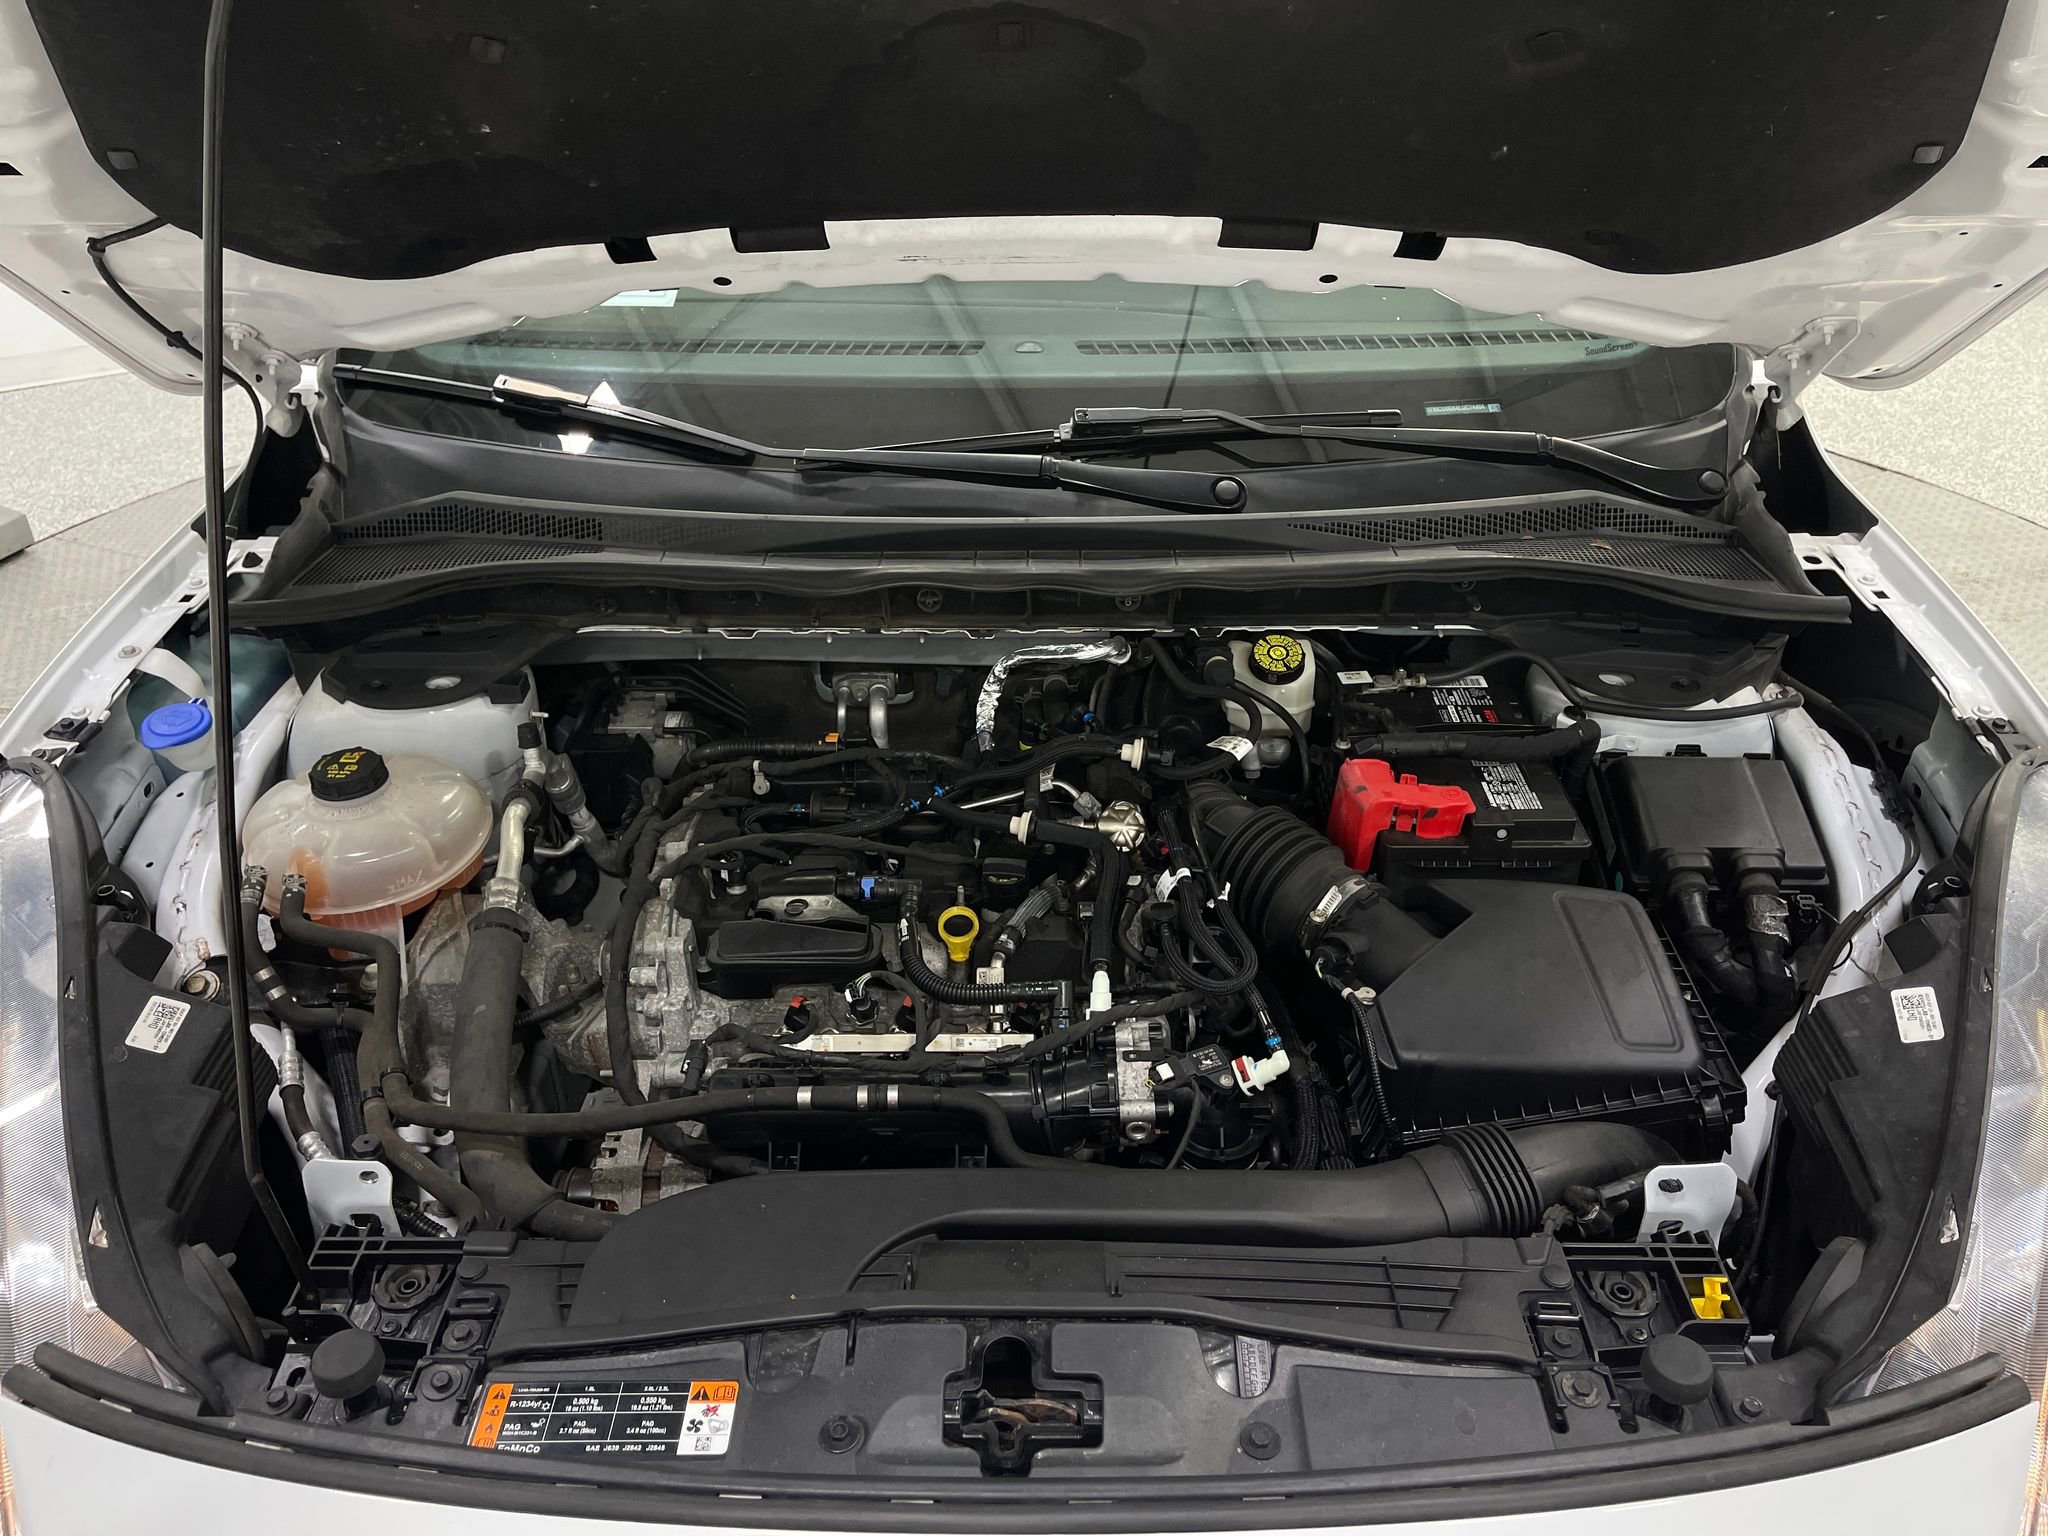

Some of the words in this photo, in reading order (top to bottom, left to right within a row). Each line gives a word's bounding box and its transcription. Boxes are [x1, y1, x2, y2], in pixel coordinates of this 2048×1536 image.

[1584, 343, 1634, 356] SoundScreen
[509, 1399, 543, 1409] R-1234yf
[572, 1397, 590, 1405] 0.500
[590, 1397, 599, 1406] kg
[640, 1396, 657, 1404] 0.550
[657, 1396, 667, 1405] kg
[503, 1423, 521, 1431] PAG
